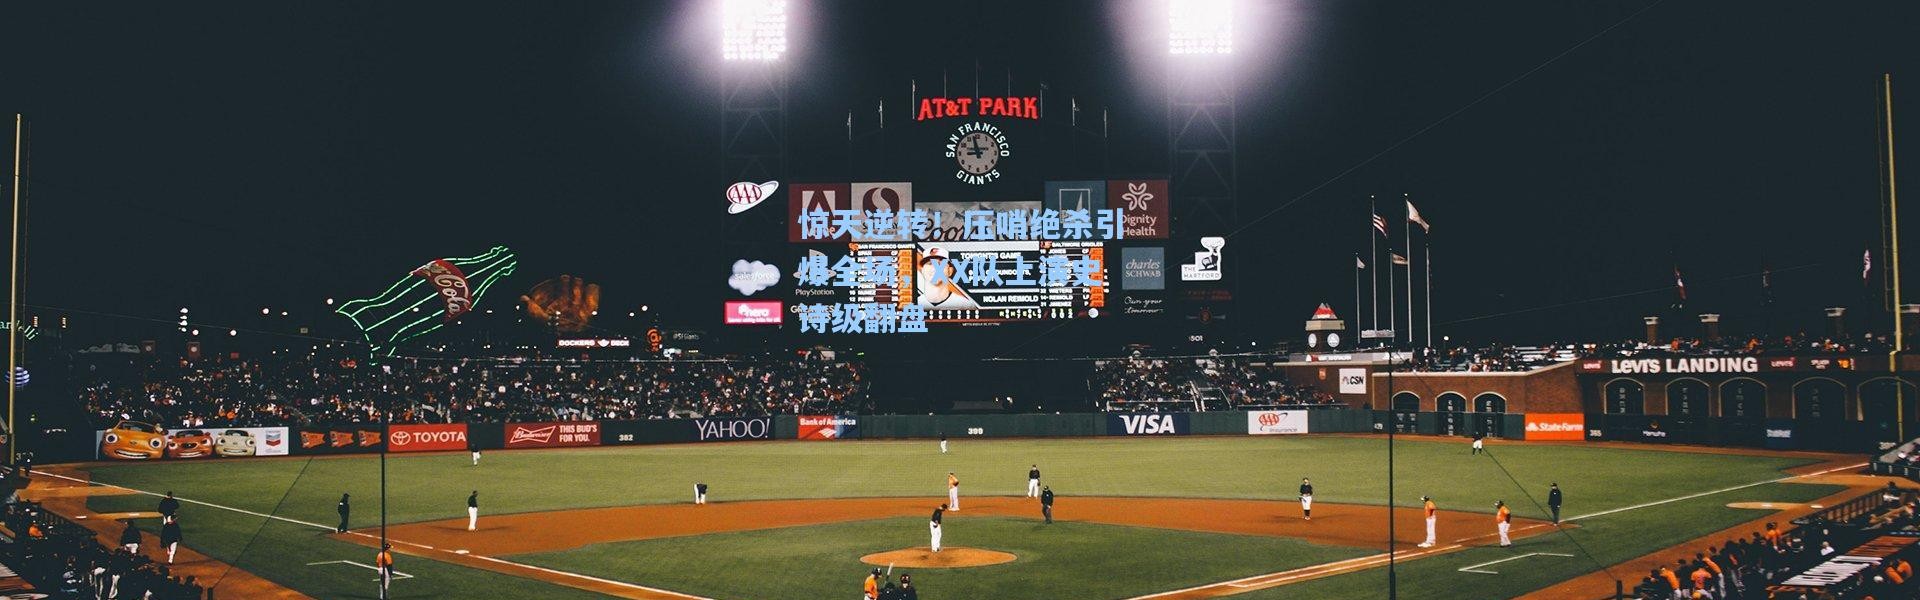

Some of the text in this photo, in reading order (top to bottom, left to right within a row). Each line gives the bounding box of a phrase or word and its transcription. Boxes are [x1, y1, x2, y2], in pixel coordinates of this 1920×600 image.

[918, 97, 1038, 120] AT&T PARK
[945, 121, 1010, 158] SAN FRANCISCO
[956, 169, 1000, 185] GIANTS
[1125, 259, 1161, 270] charles
[1125, 270, 1162, 278] SCHWAB
[795, 289, 835, 298] PlayStation
[1665, 356, 1758, 373] LANDING
[1349, 375, 1365, 386] CSN
[800, 418, 857, 427] Bank of America
[1119, 415, 1175, 434] VISA
[559, 424, 598, 433] THIS BUD'S
[696, 418, 771, 440] YAHOO!
[413, 431, 466, 443] TOYOTA
[515, 430, 551, 439] Budweiser
[559, 433, 590, 442] FOR YOU.
